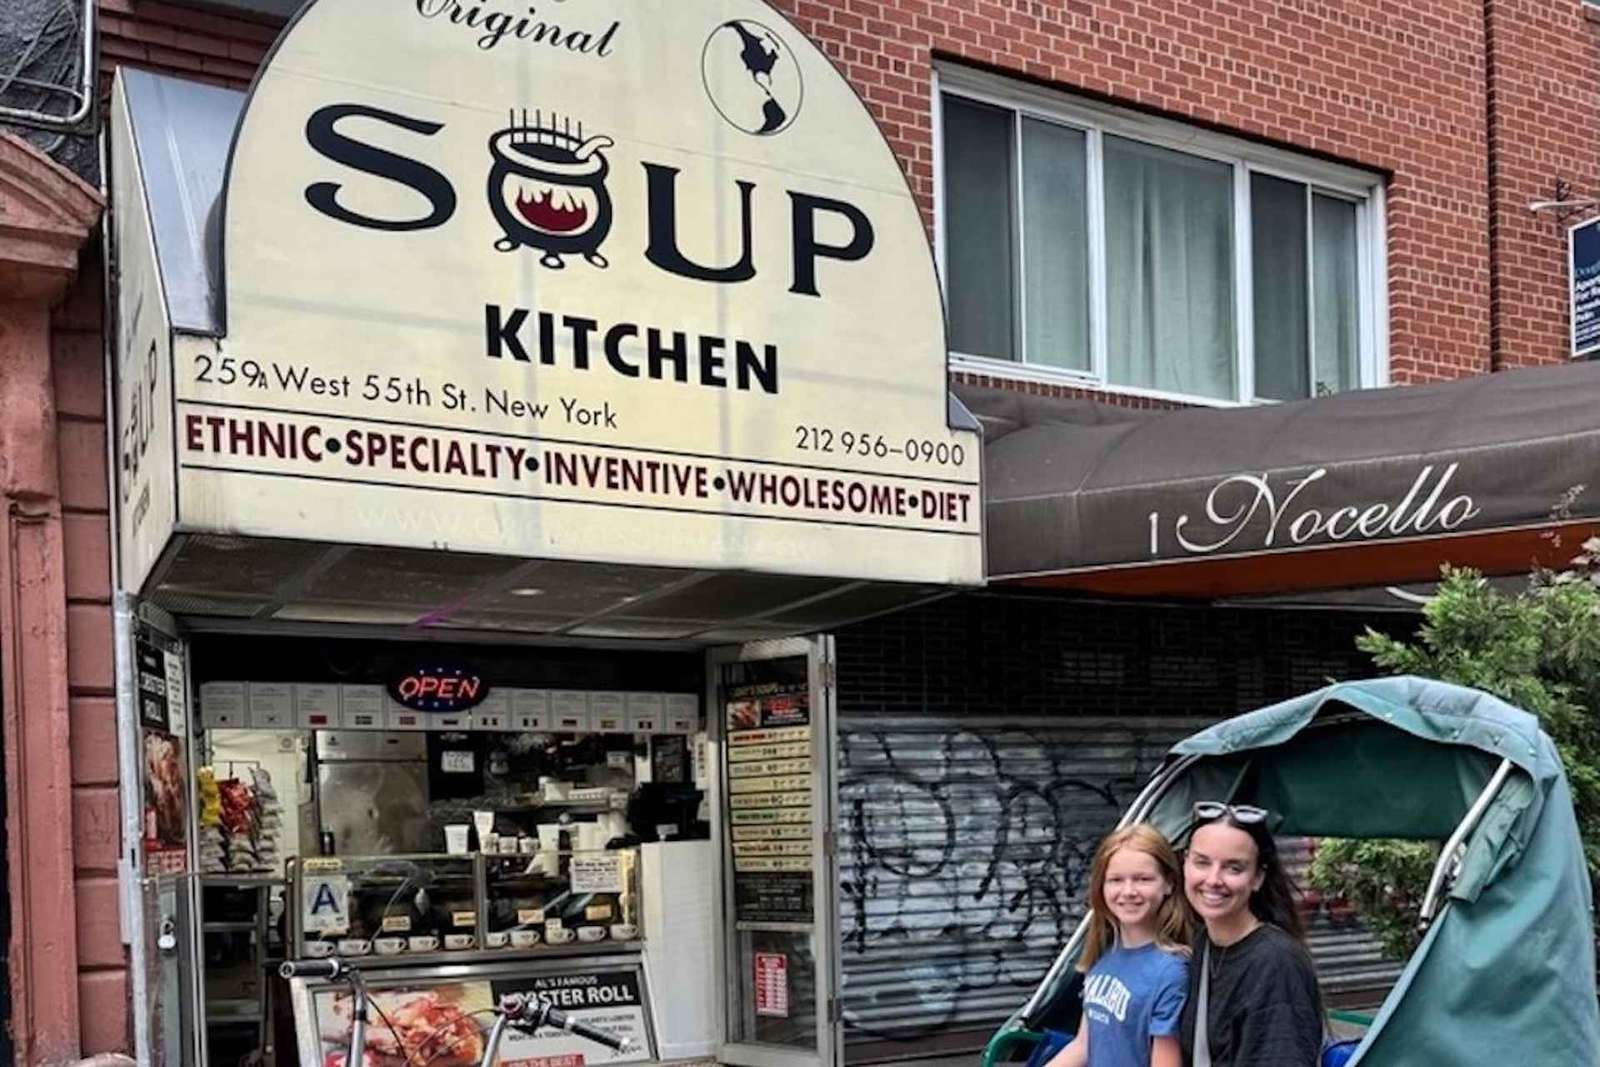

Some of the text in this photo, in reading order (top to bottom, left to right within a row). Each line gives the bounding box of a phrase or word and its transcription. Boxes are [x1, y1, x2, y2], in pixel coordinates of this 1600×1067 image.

[485, 304, 779, 394] KITCHEN
[272, 362, 351, 397] West
[362, 374, 430, 406] 55th
[442, 384, 476, 411] St.
[485, 388, 549, 419] New
[560, 396, 617, 429] York
[795, 425, 834, 452] 212
[185, 414, 970, 523] ETHNIC SPECIALTY INVENTIVE WHOLESOME DIET
[1175, 462, 1480, 553] Nocello
[399, 676, 480, 701] OPEN
[311, 883, 340, 914] A
[586, 983, 634, 1004] ROLL
